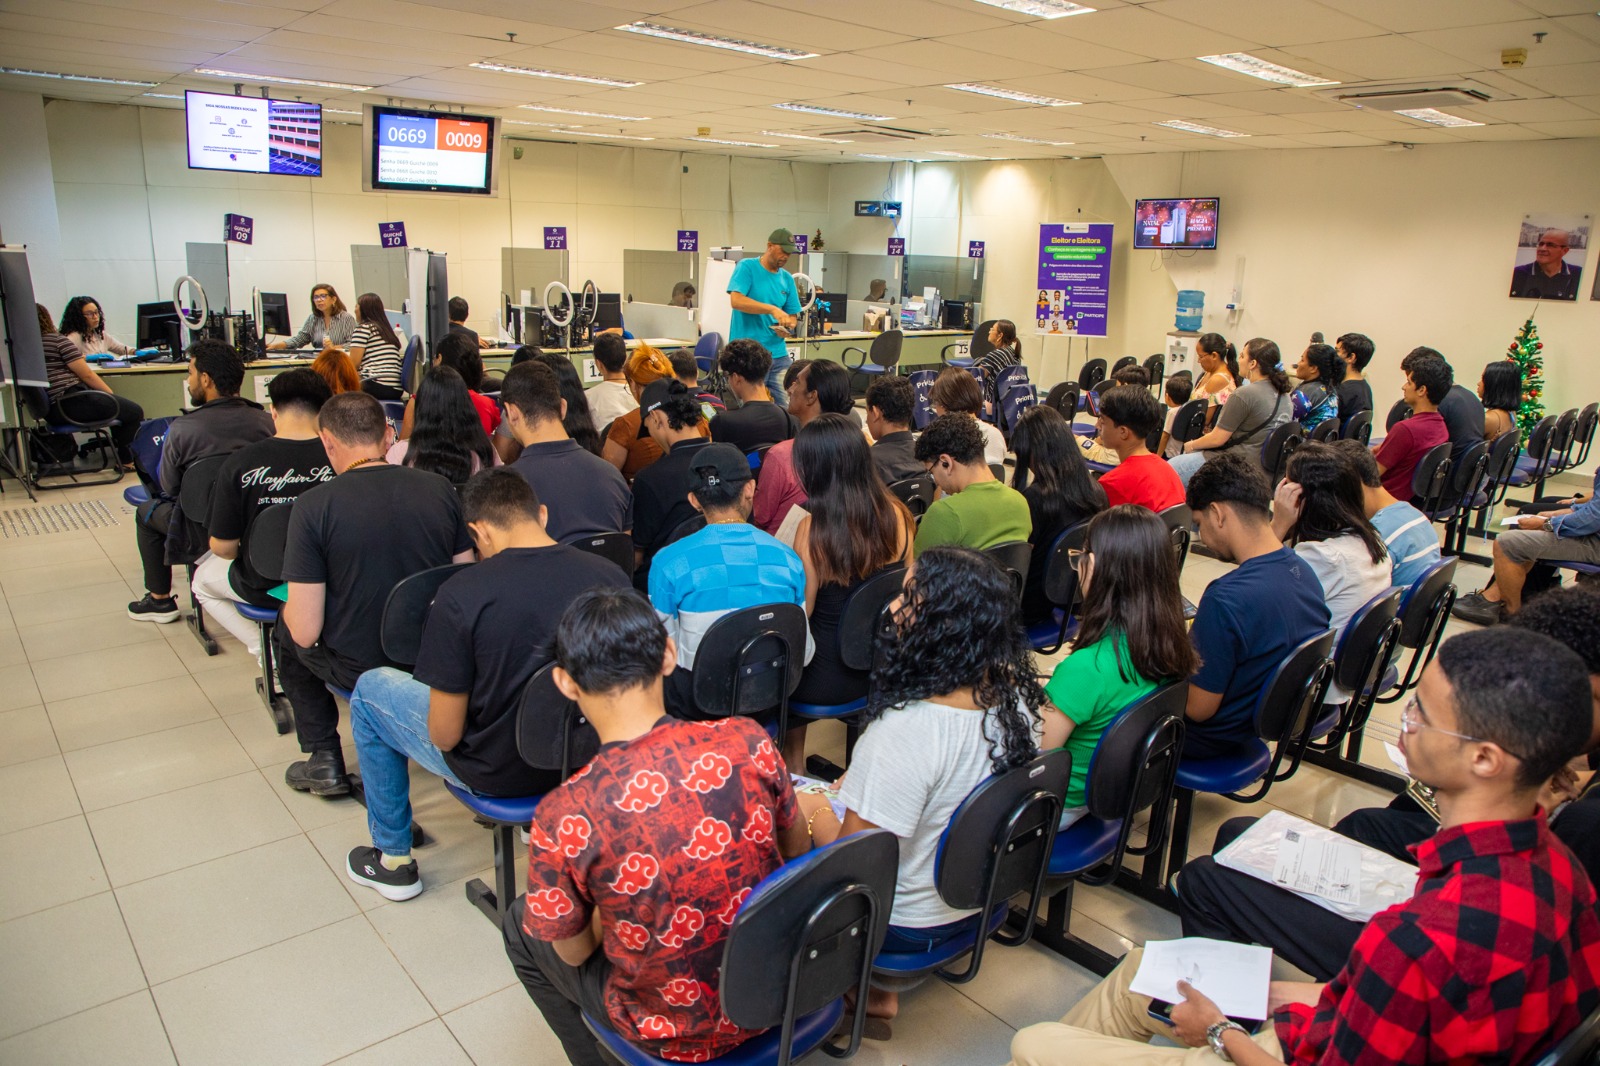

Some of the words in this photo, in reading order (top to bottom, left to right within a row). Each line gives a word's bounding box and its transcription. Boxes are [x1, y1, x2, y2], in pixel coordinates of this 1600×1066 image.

[388, 127, 427, 144] 0669
[446, 132, 482, 148] 0009
[234, 225, 250, 233] GUICHÊ
[236, 232, 248, 241] 09
[388, 237, 401, 245] 10
[241, 466, 308, 491] Mayfair
[308, 466, 337, 482] Stu
